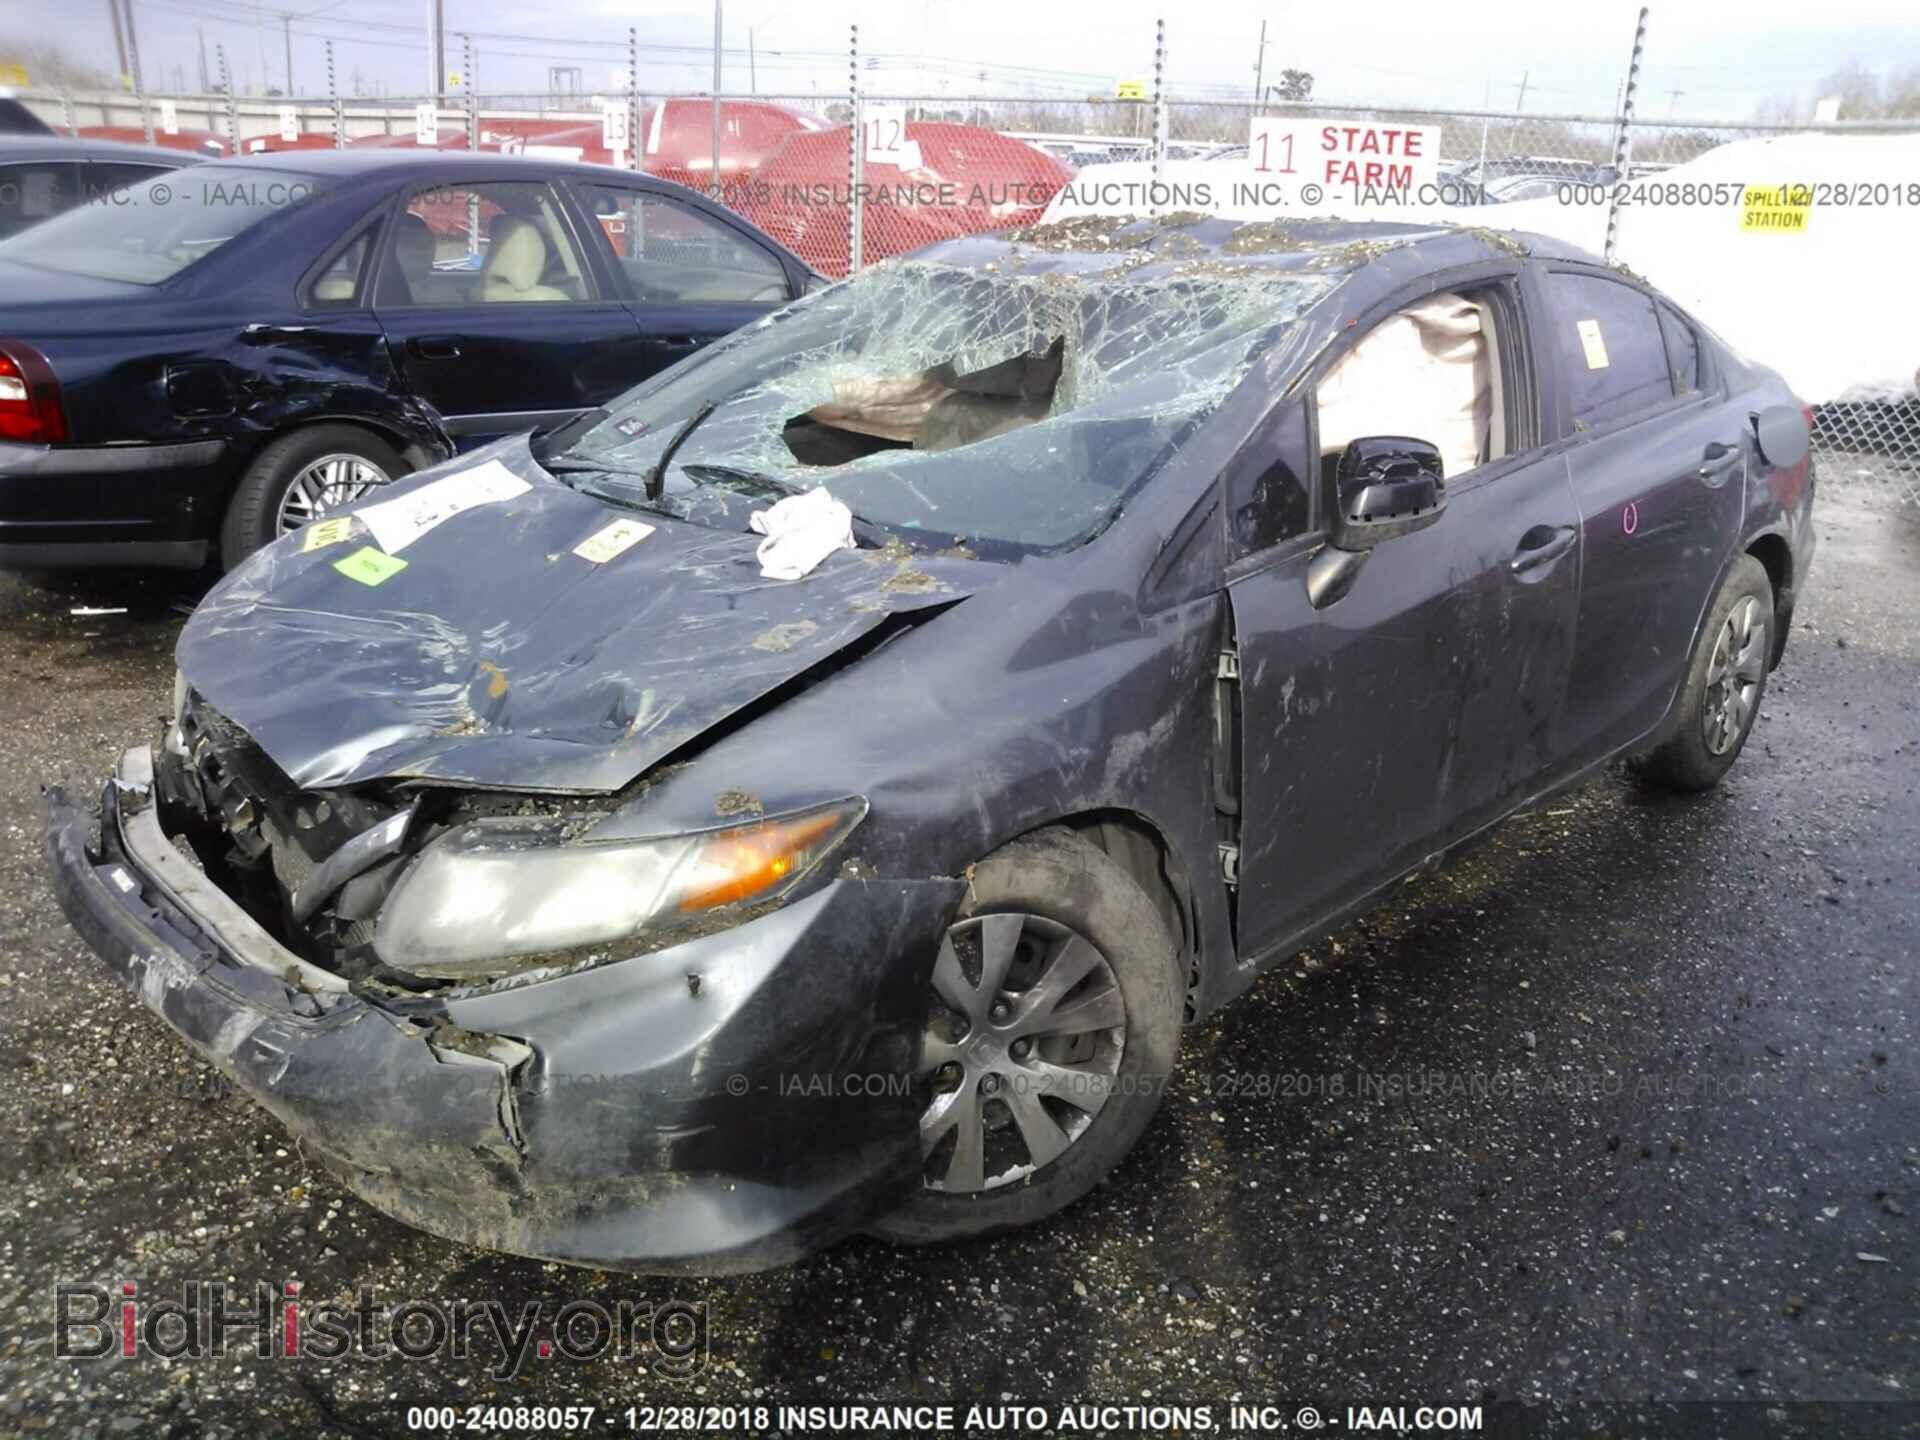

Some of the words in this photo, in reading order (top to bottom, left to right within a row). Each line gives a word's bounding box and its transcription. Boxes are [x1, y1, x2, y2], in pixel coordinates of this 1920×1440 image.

[605, 112, 627, 141] 13
[871, 119, 900, 151] 12
[1320, 125, 1423, 158] STATE
[1253, 131, 1299, 175] 11
[1324, 159, 1414, 190] FARM
[1744, 210, 1804, 228] STATION
